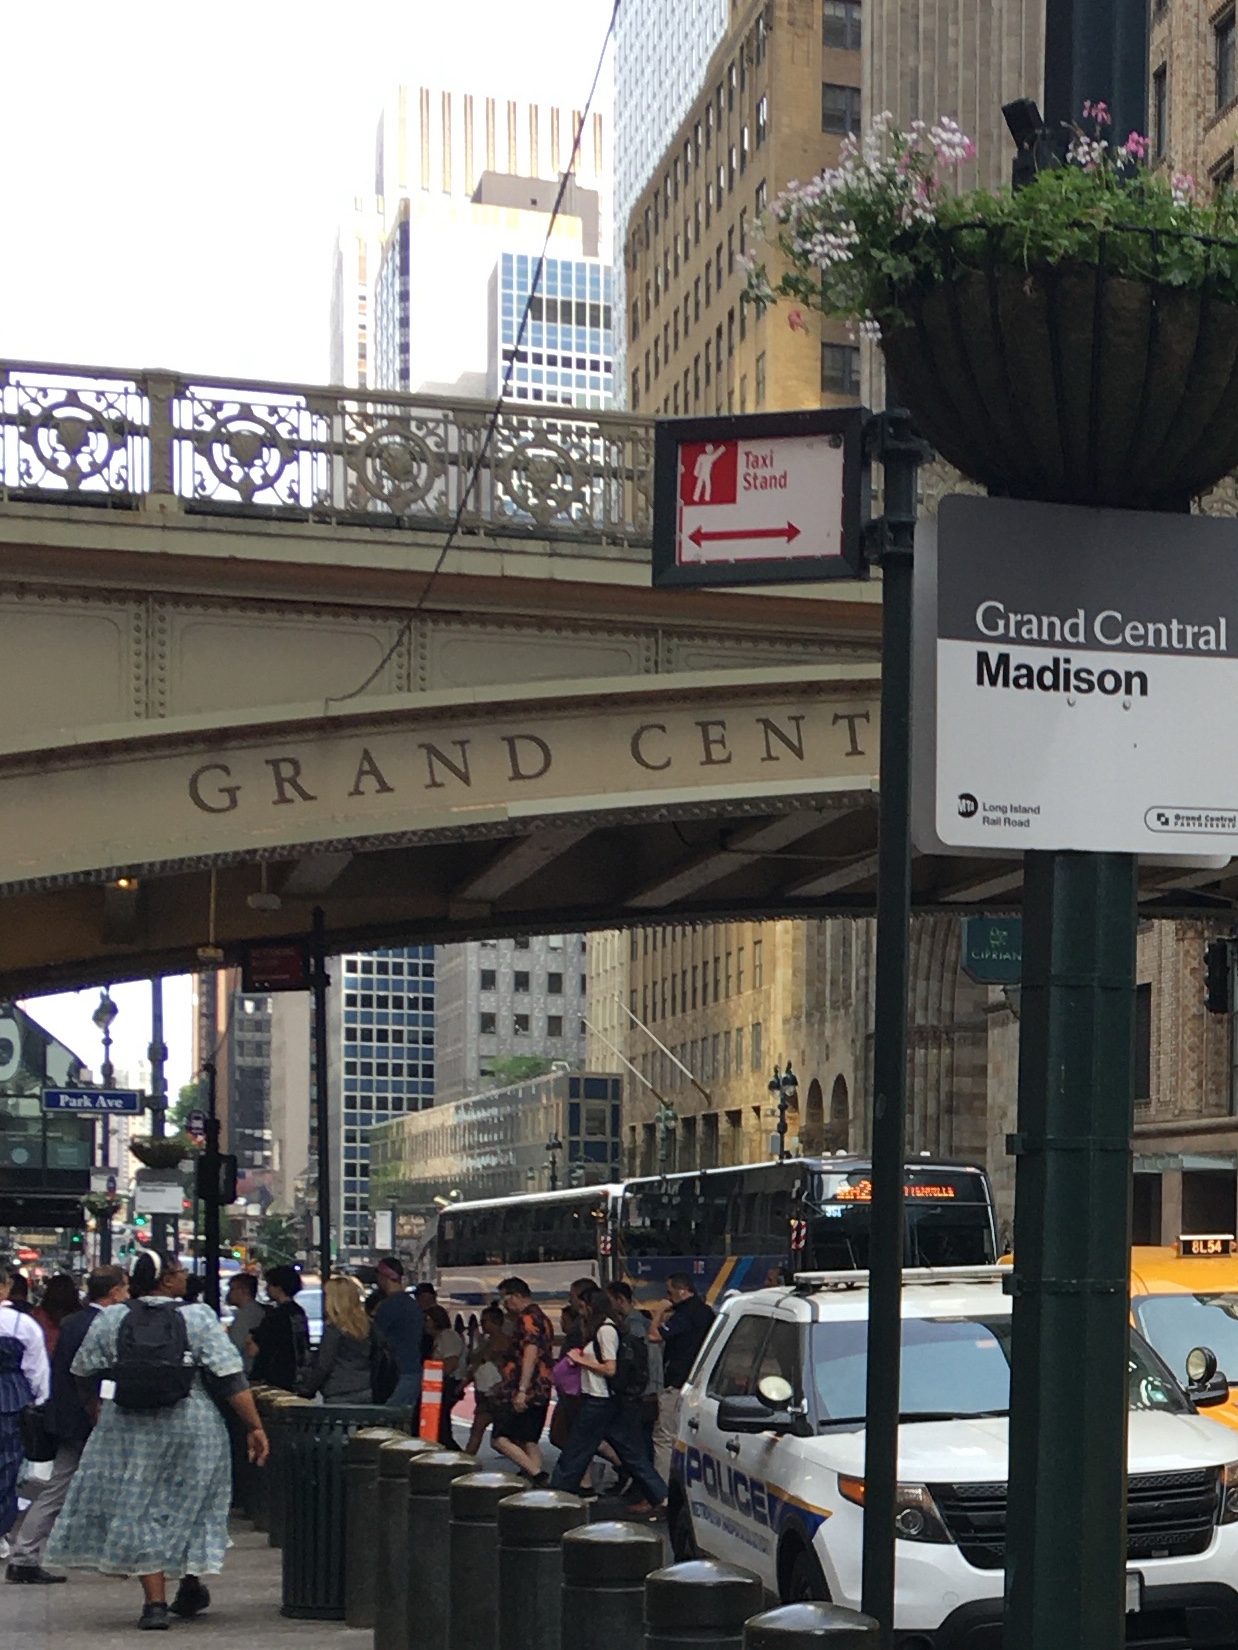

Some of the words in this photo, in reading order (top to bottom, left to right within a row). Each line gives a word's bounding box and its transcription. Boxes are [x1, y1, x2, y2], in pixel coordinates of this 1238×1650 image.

[743, 450, 774, 469] Taxi
[743, 470, 788, 491] Stand
[975, 600, 1087, 644] Grand
[1093, 610, 1227, 651] Central
[976, 651, 1148, 697] Madison
[188, 734, 553, 815] GRAND
[630, 711, 871, 771] CENT
[983, 803, 1008, 814] Long
[1010, 804, 1040, 815] Island
[982, 816, 1001, 826] Rail
[1004, 817, 1030, 828] Road
[1205, 815, 1236, 823] Central
[971, 951, 1021, 961] CIPRIAN
[59, 1094, 92, 1107] Park
[95, 1095, 124, 1108] Ave
[1192, 1240, 1222, 1254] 8L54
[686, 1445, 771, 1527] POLICE
